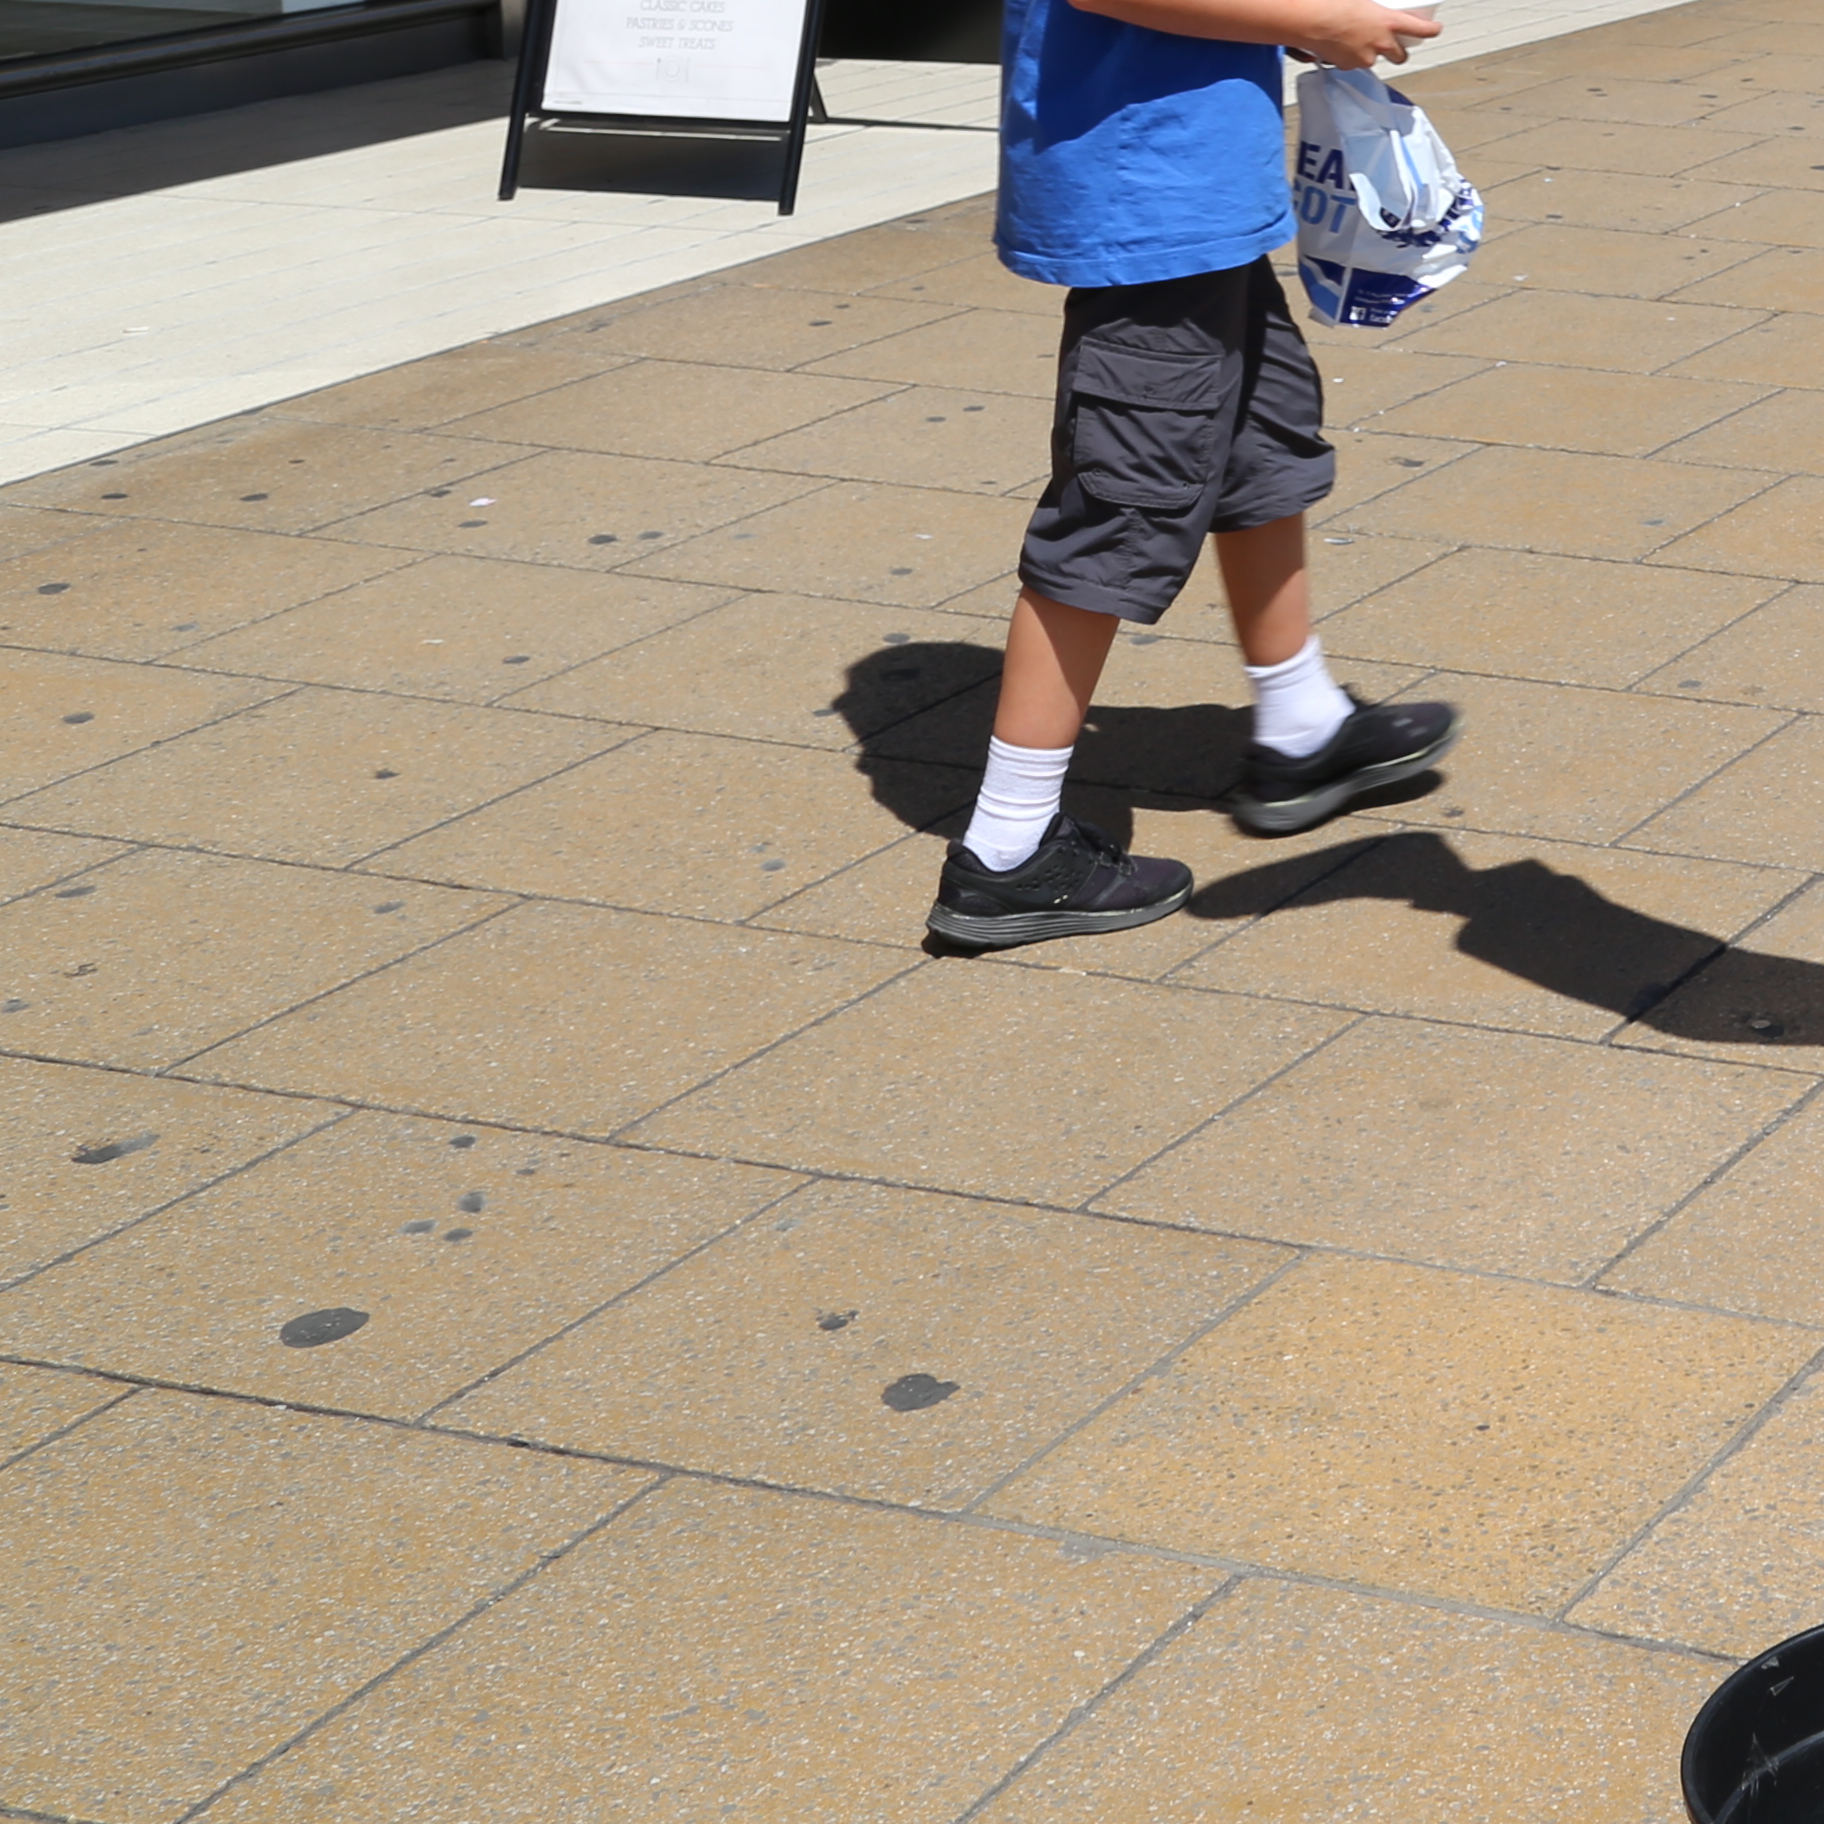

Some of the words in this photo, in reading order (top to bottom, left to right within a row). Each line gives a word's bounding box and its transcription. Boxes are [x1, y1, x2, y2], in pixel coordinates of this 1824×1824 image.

[640, 0, 688, 11] CLASSIC
[689, 0, 726, 13] CAKES
[625, 17, 675, 30] PASTRIES
[677, 19, 686, 30] &
[688, 19, 734, 32] SCONES
[638, 36, 675, 48] SWEET
[677, 37, 717, 50] TREATS
